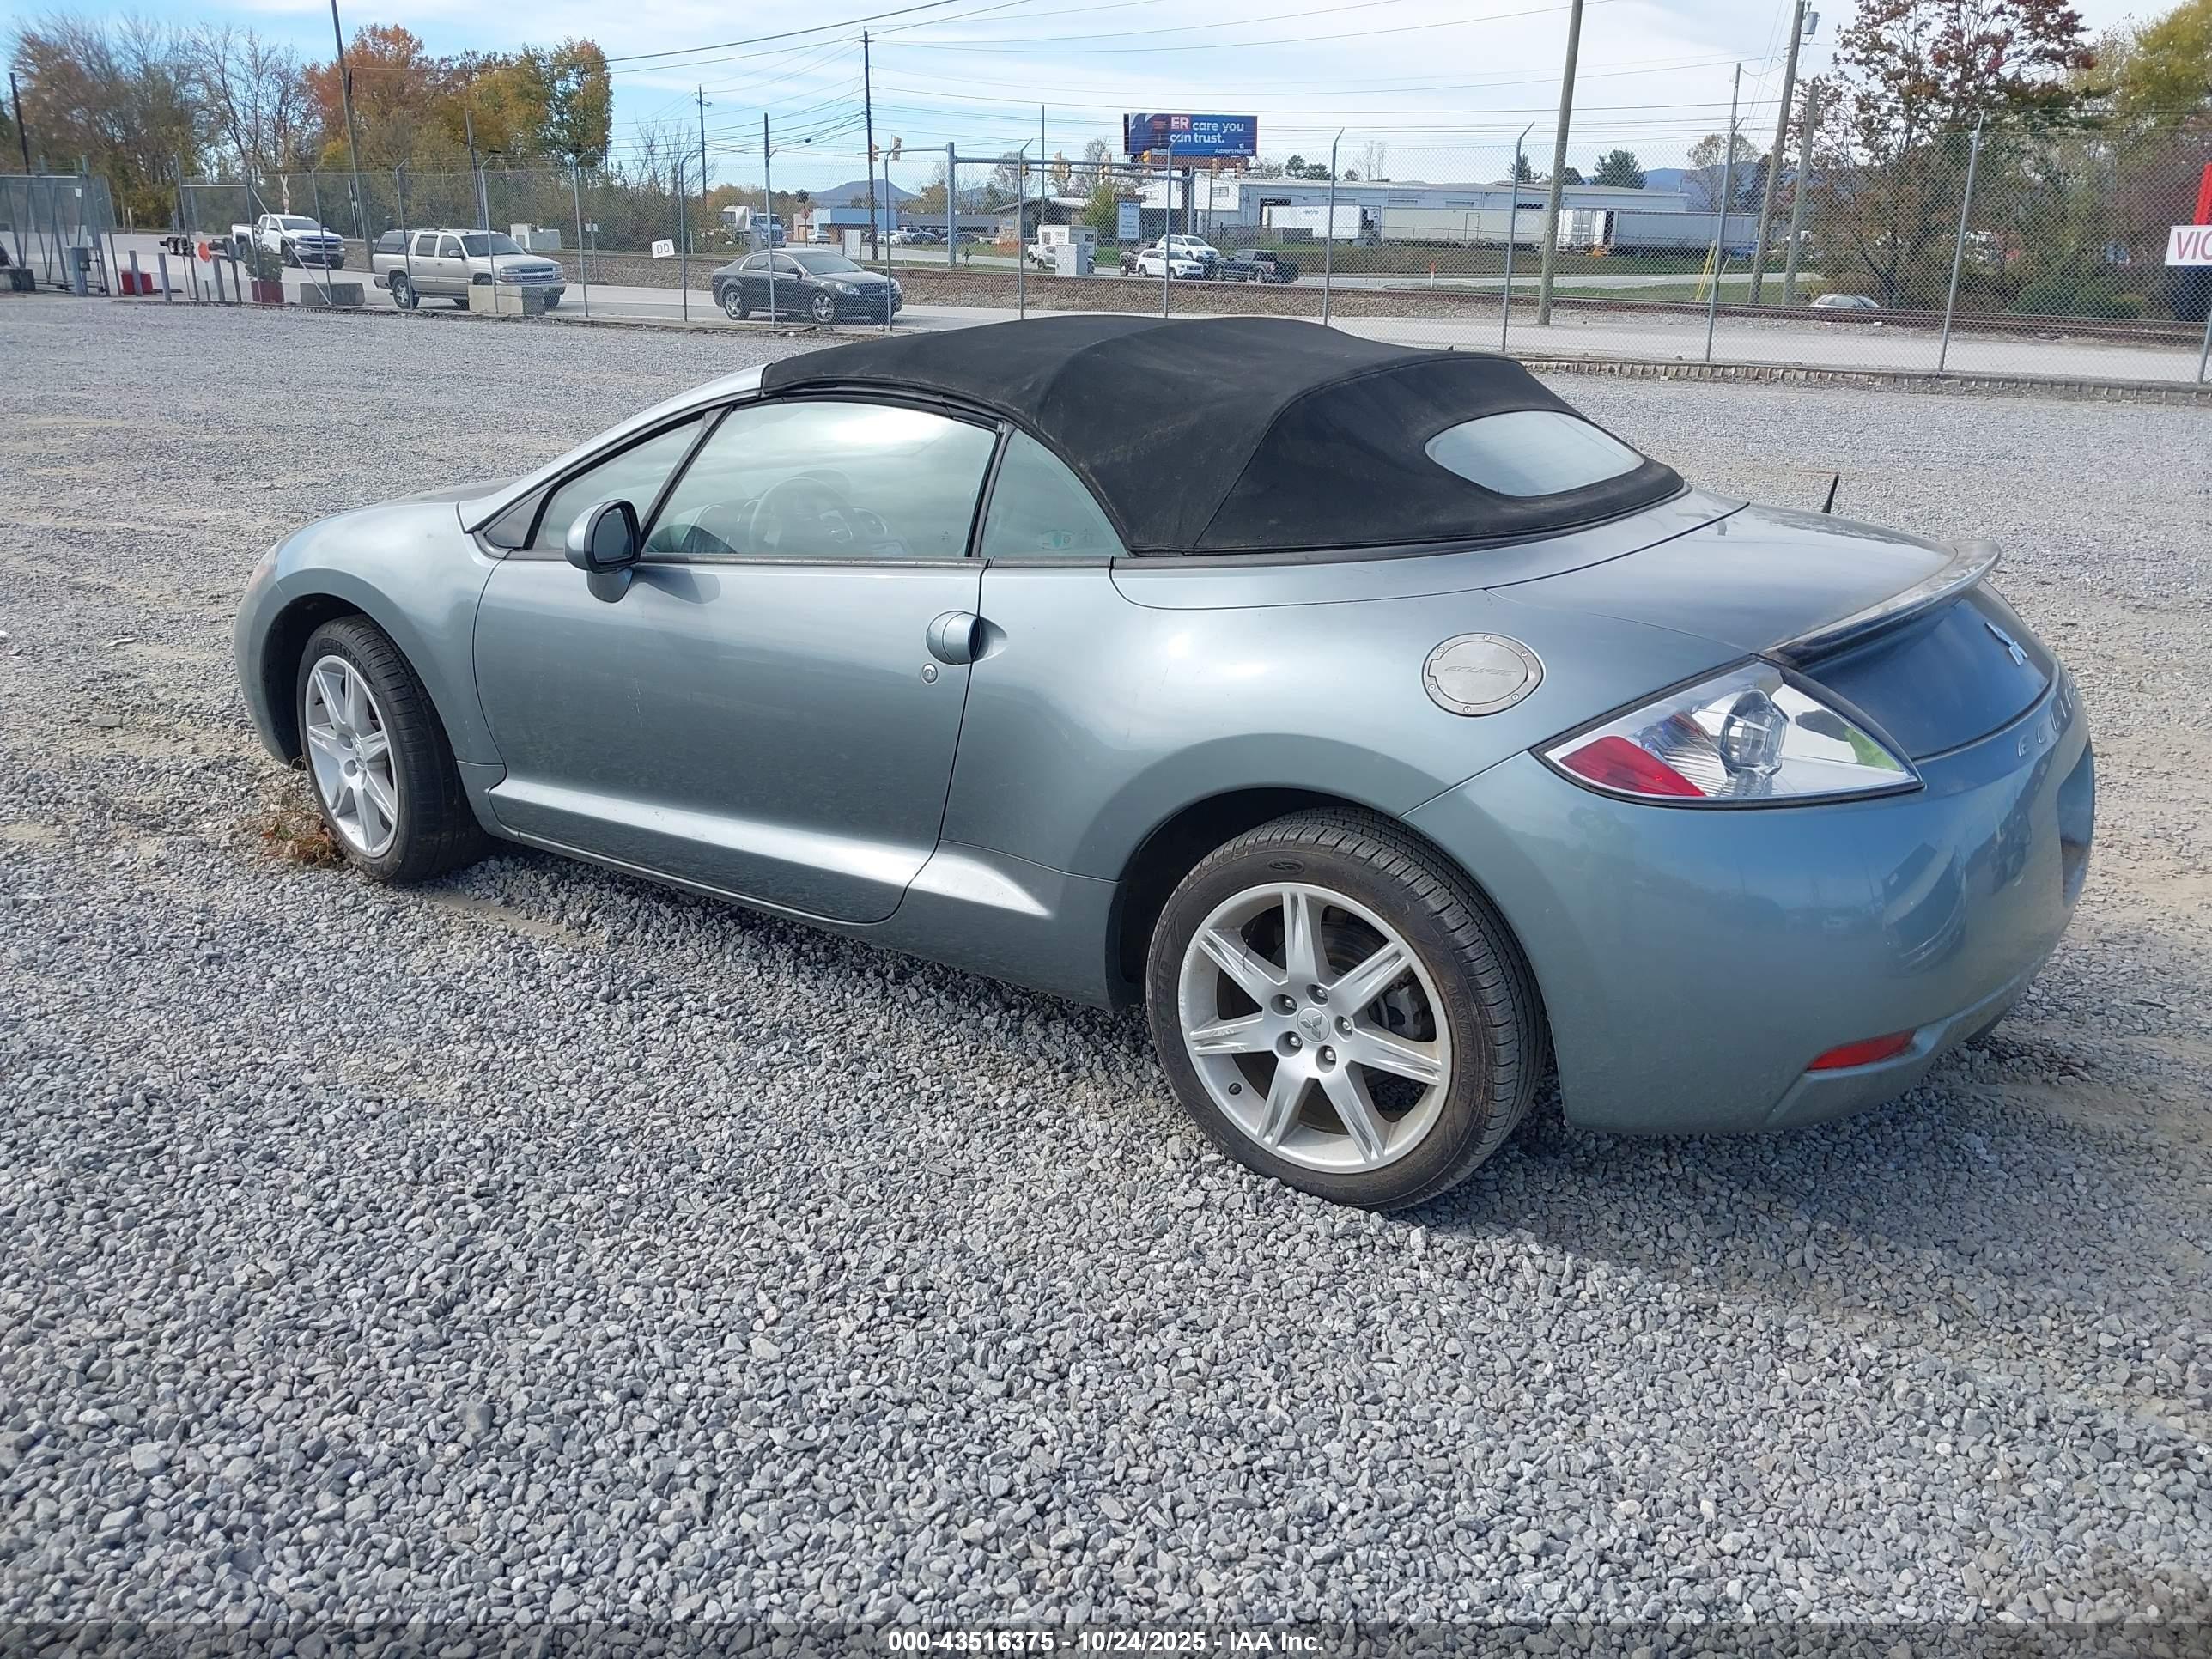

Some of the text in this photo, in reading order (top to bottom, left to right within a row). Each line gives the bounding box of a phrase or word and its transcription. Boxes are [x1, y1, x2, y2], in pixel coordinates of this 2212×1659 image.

[1170, 117, 1244, 133] ER care you
[1170, 132, 1225, 143] can trust.
